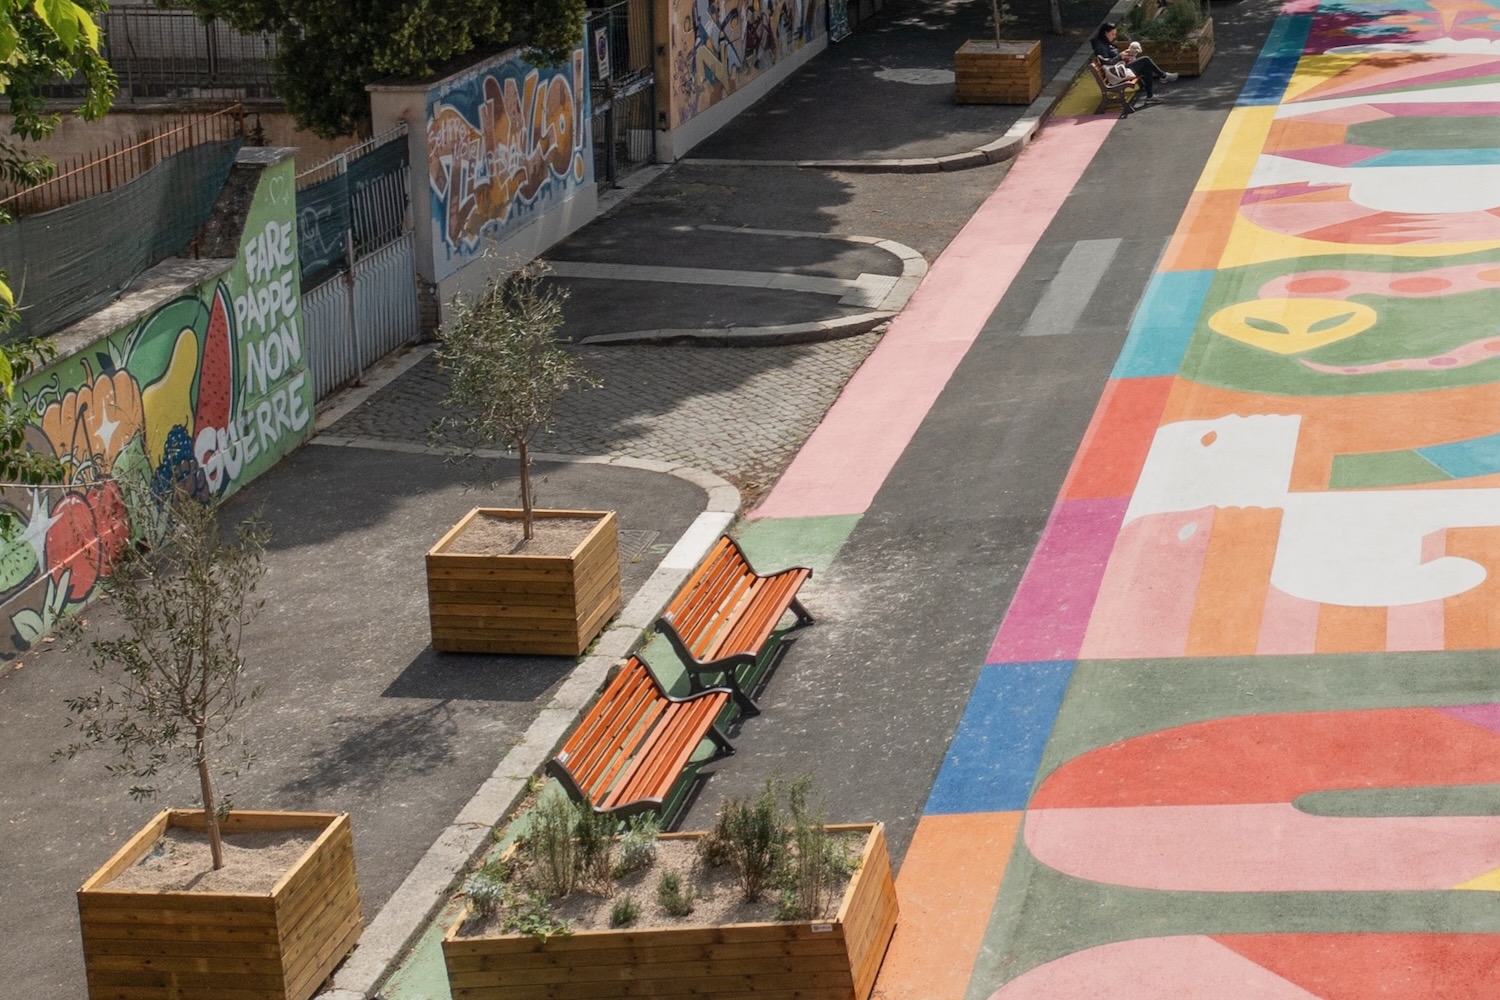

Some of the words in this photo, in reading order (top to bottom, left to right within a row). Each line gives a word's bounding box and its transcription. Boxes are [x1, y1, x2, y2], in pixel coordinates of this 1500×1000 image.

[245, 220, 295, 283] FARE
[235, 270, 298, 340] PAPPE
[247, 315, 301, 395] NON
[195, 376, 310, 494] GUERRE
